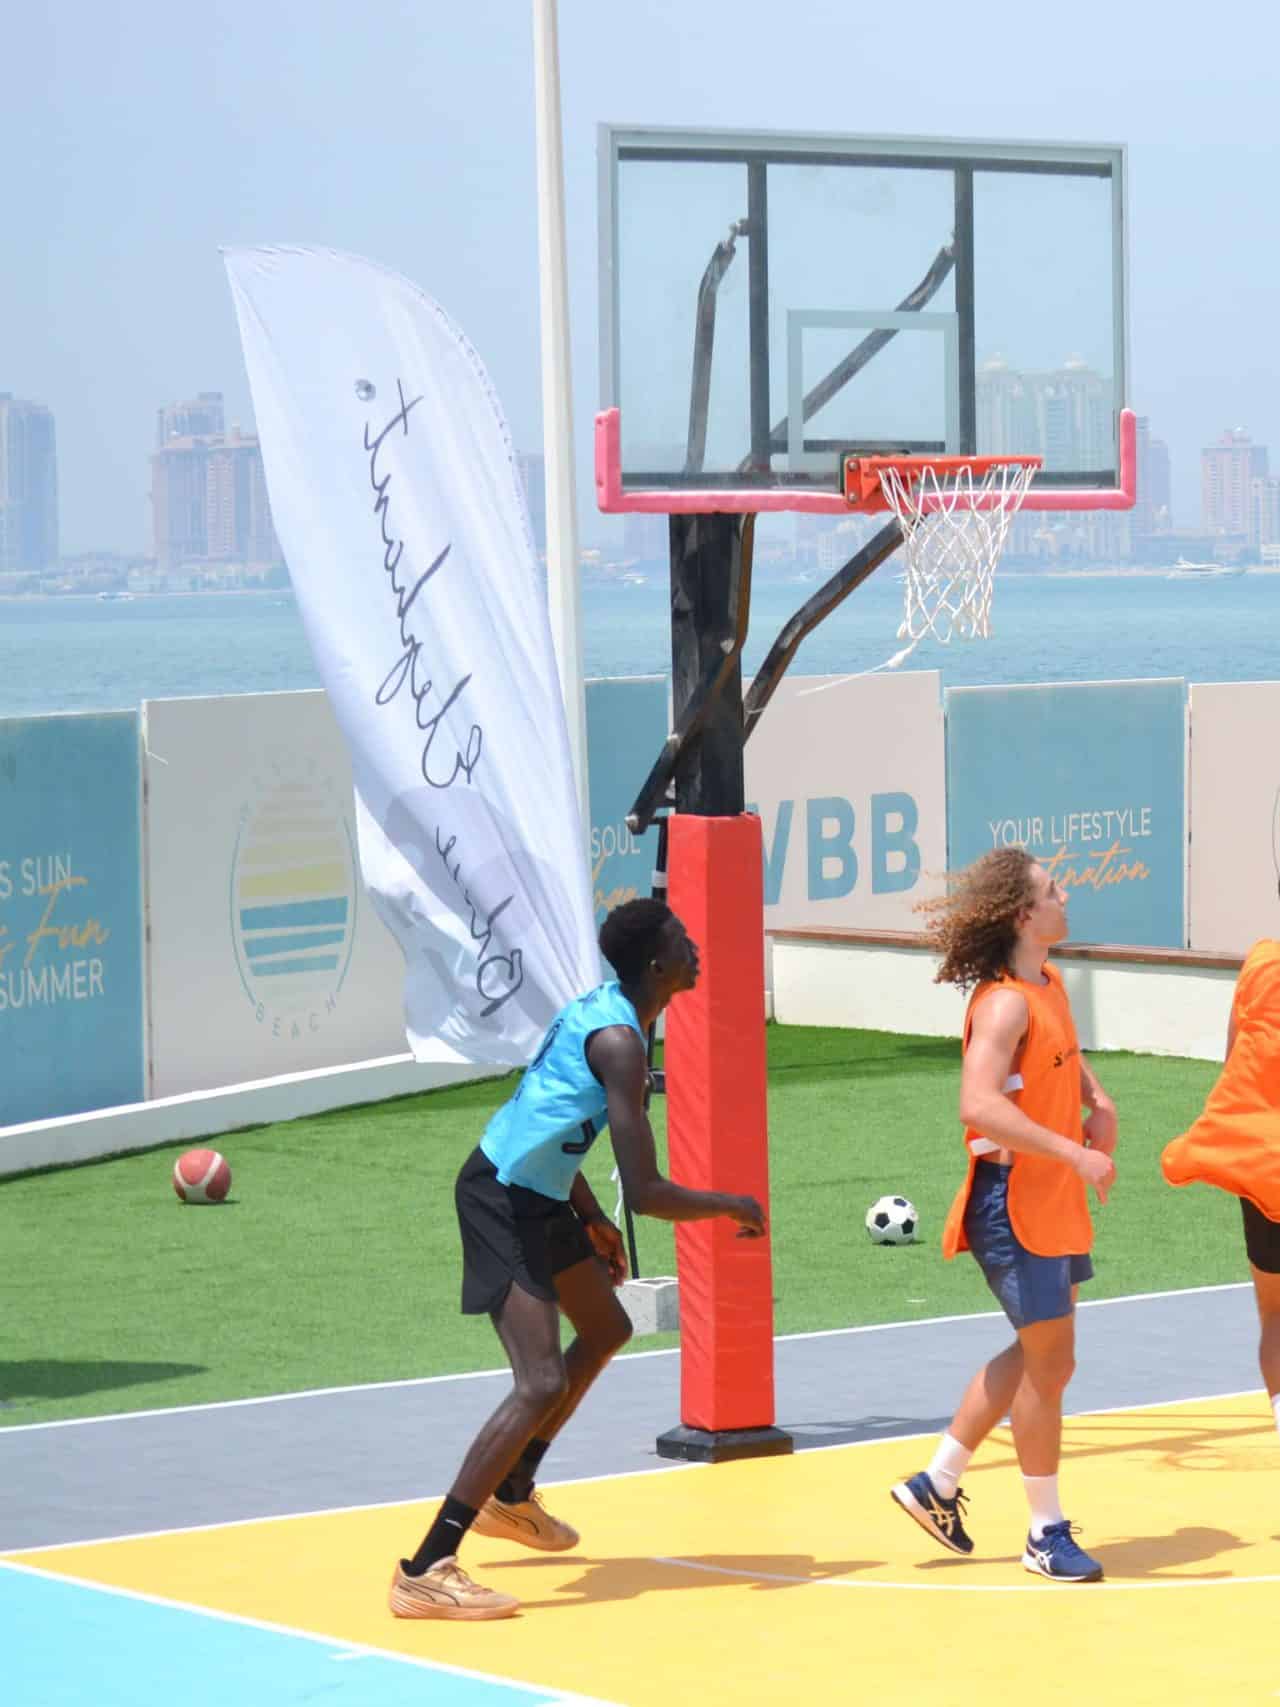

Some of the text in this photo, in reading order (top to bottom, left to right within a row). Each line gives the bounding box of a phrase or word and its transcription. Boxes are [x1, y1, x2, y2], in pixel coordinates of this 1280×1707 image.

[988, 807, 1152, 849] YOUR LIFESTYLE
[21, 853, 72, 896] SUN
[0, 958, 105, 1010] SUMMER
